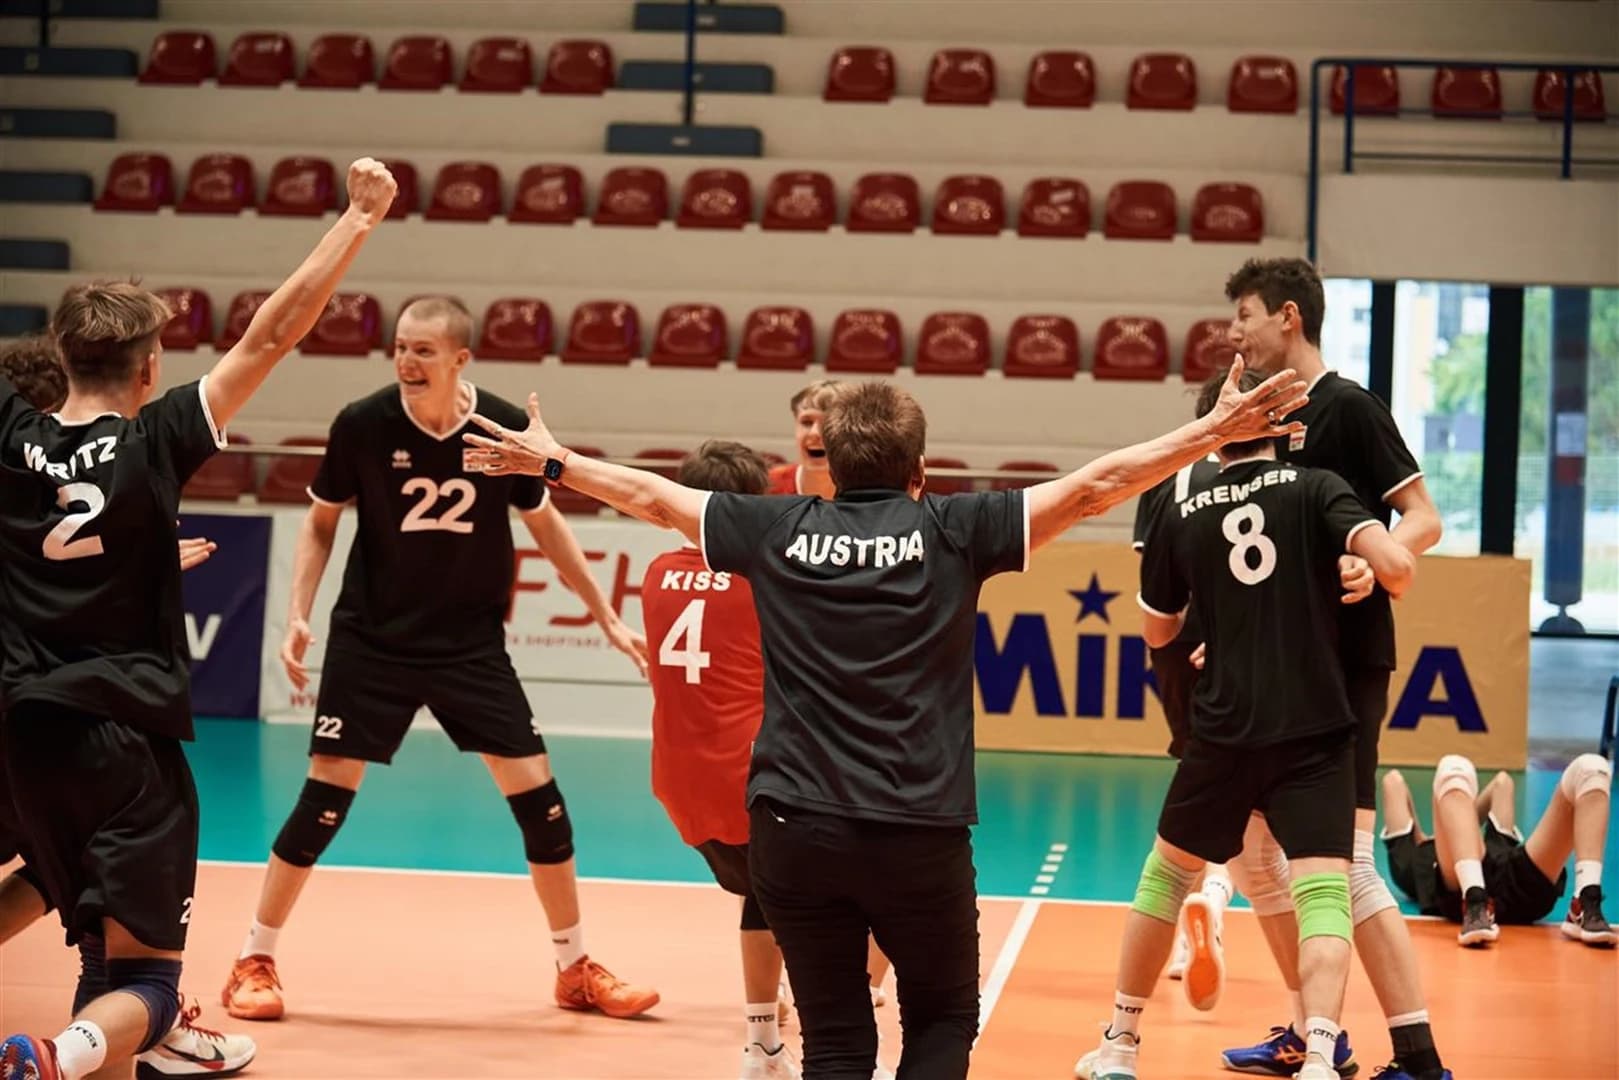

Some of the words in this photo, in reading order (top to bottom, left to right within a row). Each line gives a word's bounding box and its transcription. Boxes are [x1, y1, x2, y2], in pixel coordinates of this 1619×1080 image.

[42, 482, 104, 560] 2
[400, 477, 477, 534] 22
[1181, 469, 1298, 518] KREMSER
[785, 529, 924, 568] AUSTRIA
[1222, 503, 1277, 586] 8
[660, 570, 732, 591] KISS
[659, 599, 710, 685] 4
[974, 611, 1489, 734] MIKA
[315, 715, 343, 739] 22
